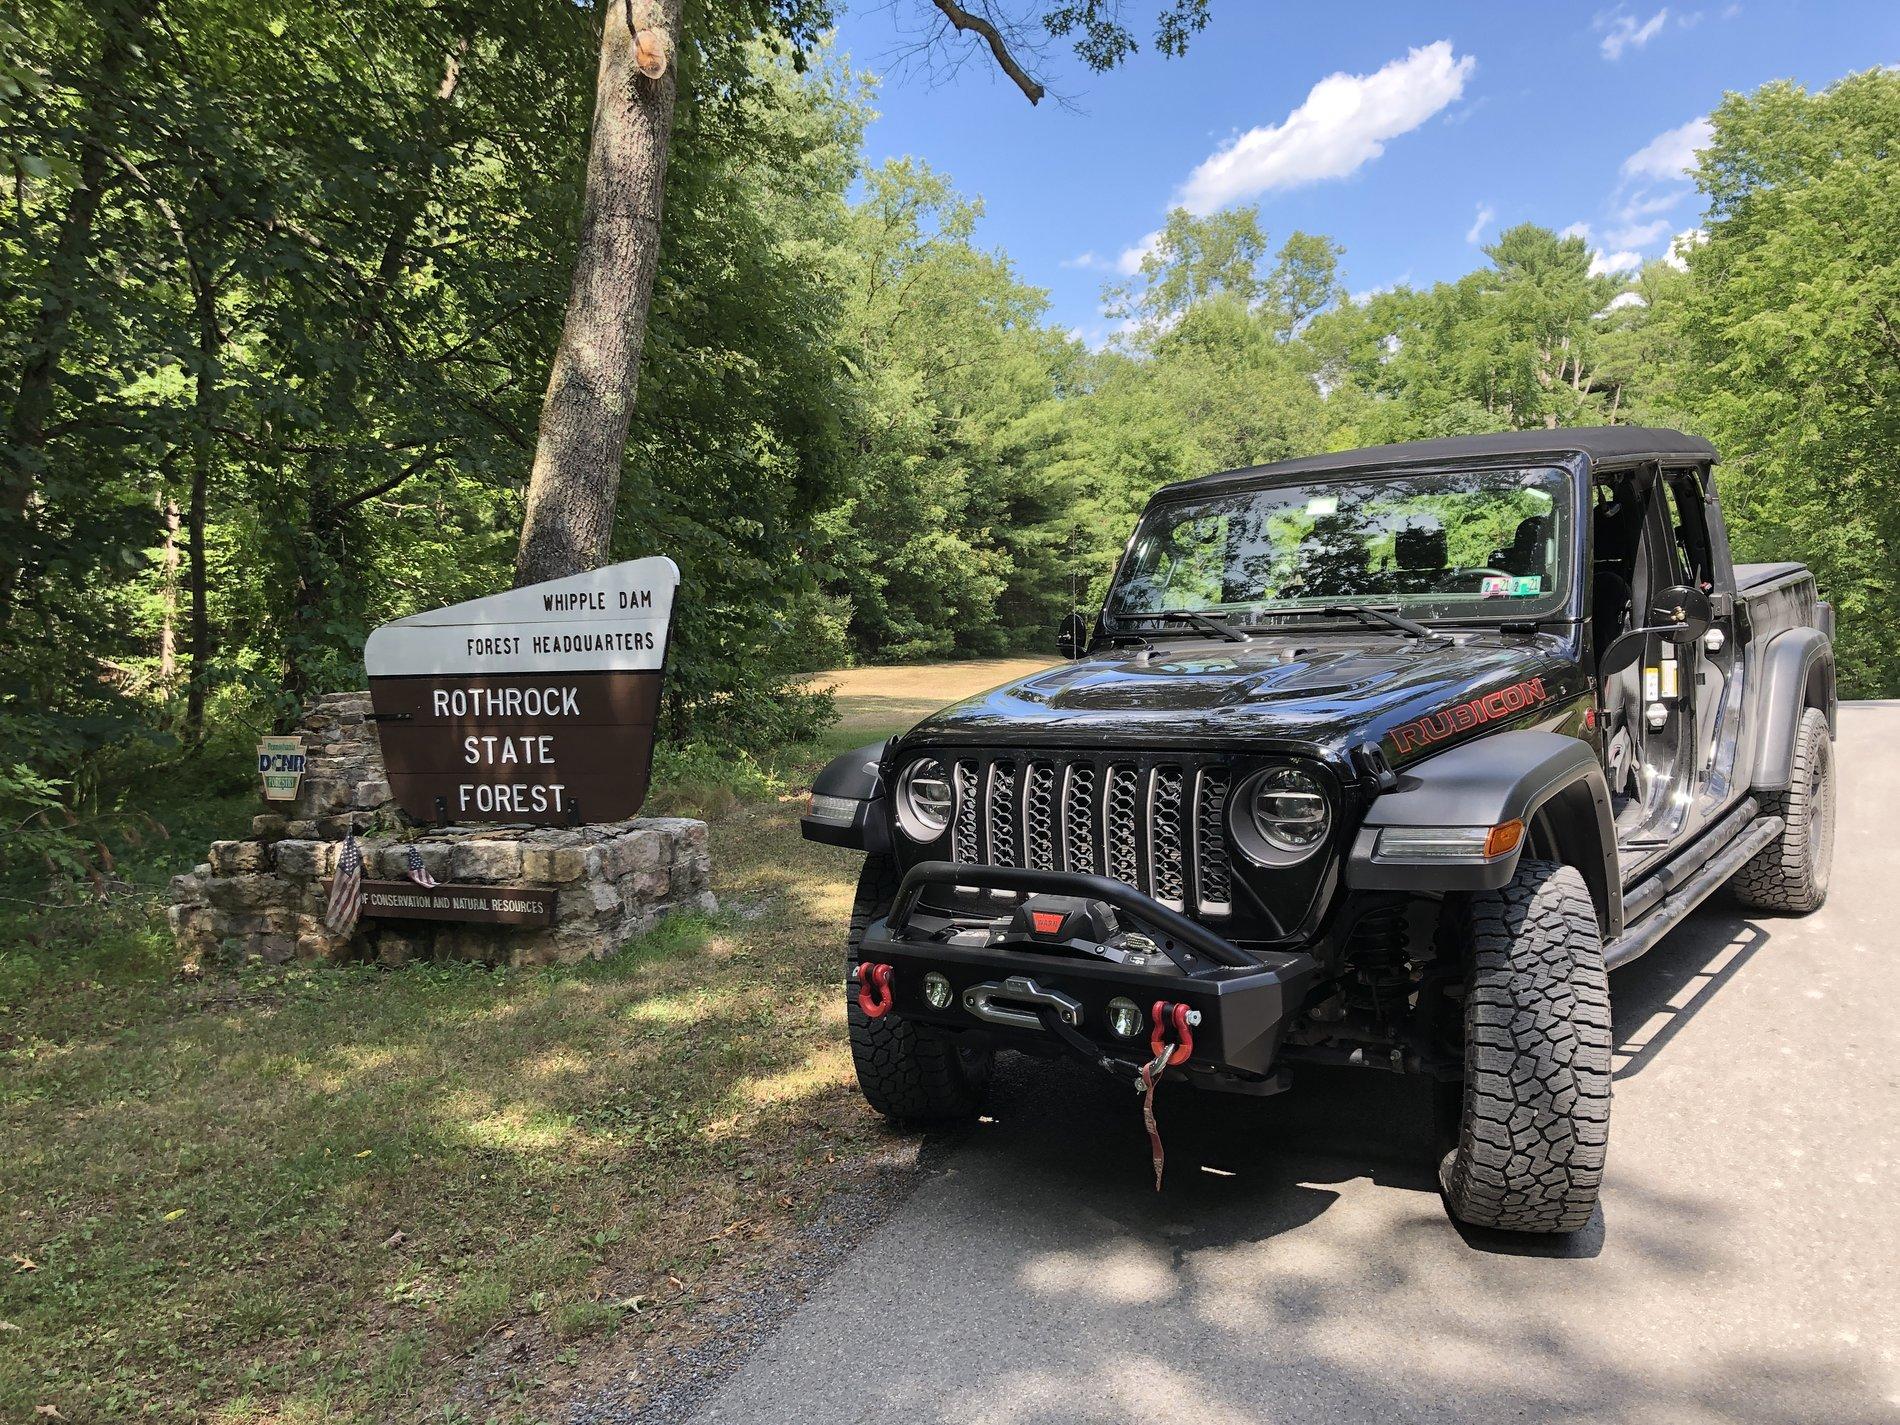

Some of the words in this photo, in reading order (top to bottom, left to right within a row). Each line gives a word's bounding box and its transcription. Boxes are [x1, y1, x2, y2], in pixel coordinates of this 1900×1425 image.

[543, 592, 606, 611] WHIPPLE
[619, 590, 652, 609] DAM
[467, 637, 520, 656] FOREST
[533, 632, 654, 654] HEADQUARTERS
[433, 687, 581, 717] ROTHROCK
[1390, 677, 1547, 754] RUBICON
[464, 735, 555, 764] STATE
[260, 754, 305, 772] DCNR
[459, 784, 565, 812] FOREST
[371, 893, 431, 908] CONSERVATION
[433, 896, 450, 909] AND
[452, 897, 490, 911] NATURAL
[491, 899, 544, 914] RESOURCES
